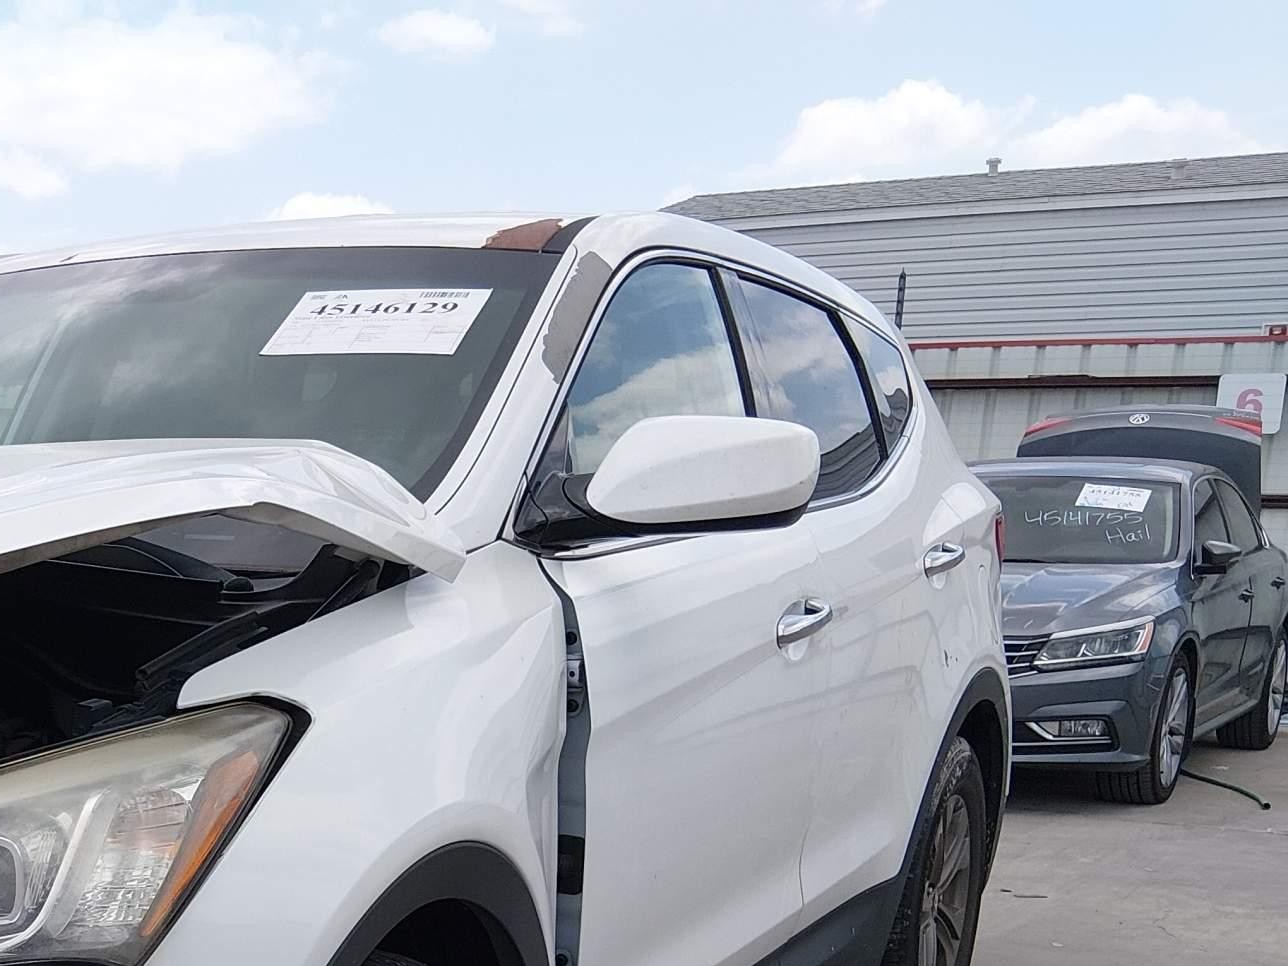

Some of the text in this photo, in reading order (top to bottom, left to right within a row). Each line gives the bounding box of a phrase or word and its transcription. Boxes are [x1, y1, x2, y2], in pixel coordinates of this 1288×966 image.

[309, 301, 459, 316] 45146129
[1023, 509, 1144, 526] 45141755
[1105, 523, 1151, 544] Hail
